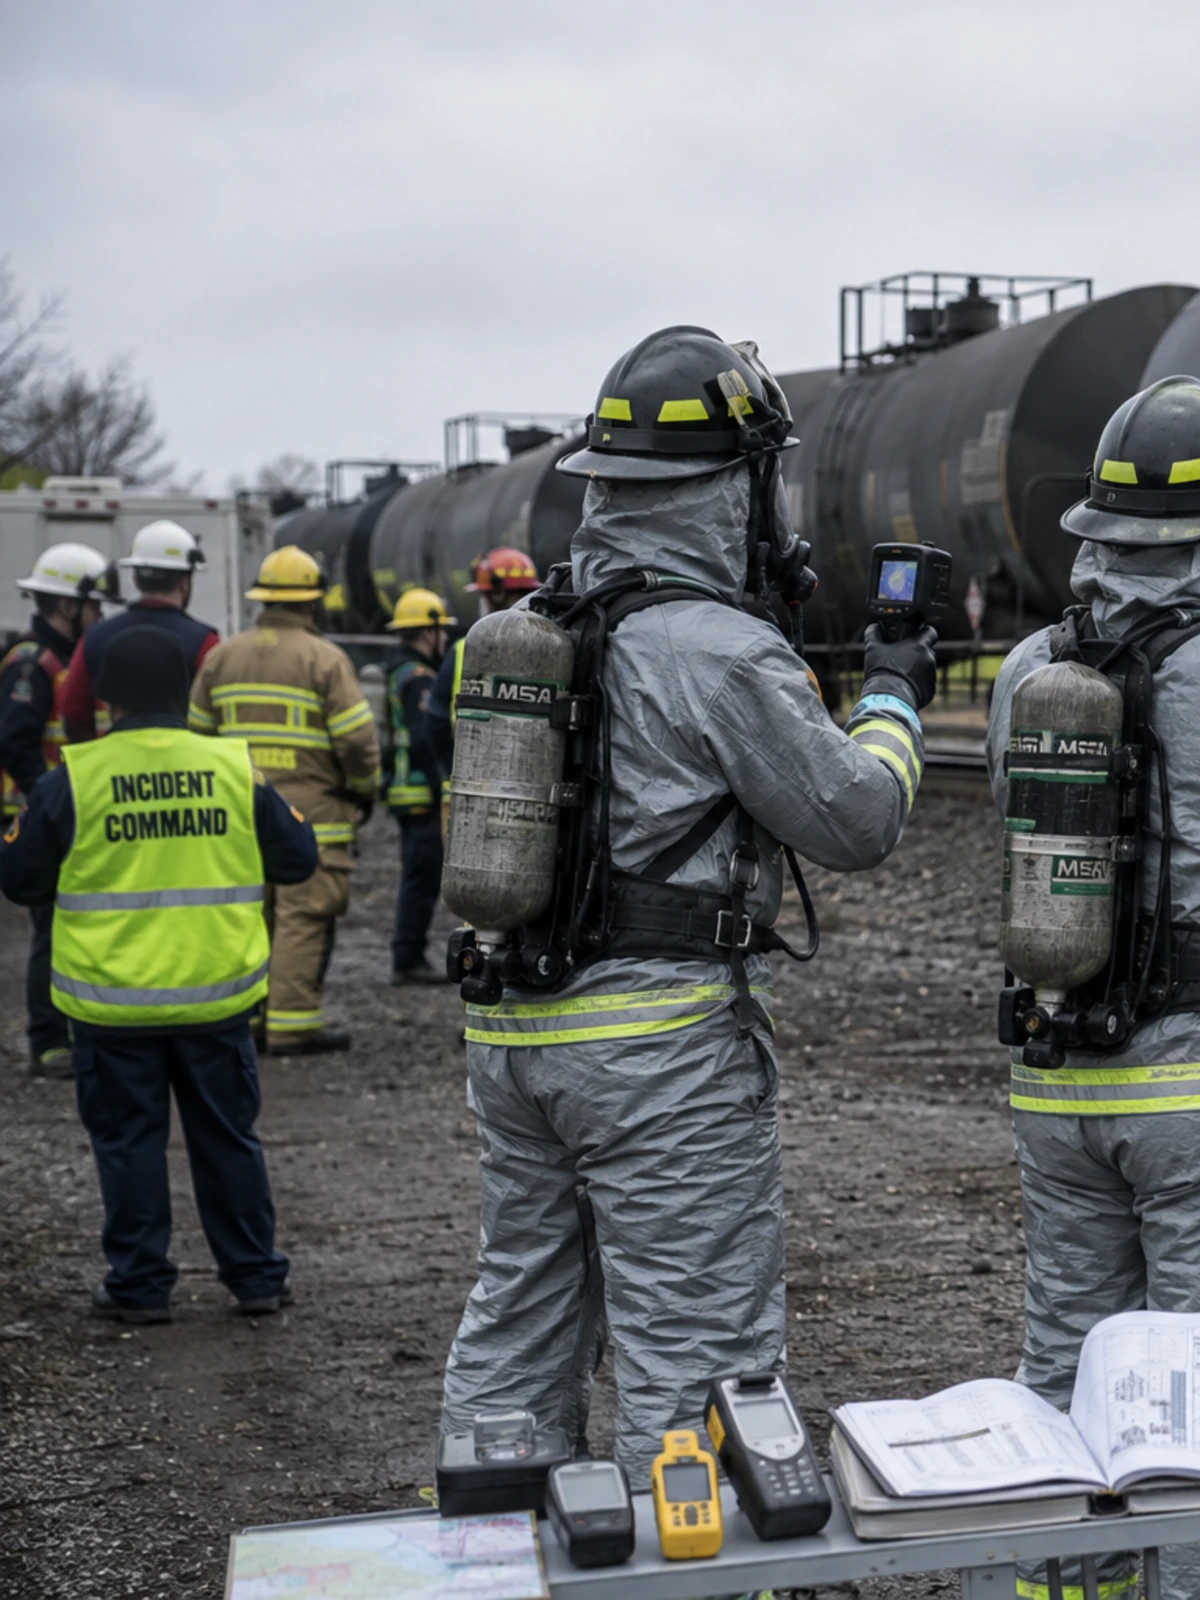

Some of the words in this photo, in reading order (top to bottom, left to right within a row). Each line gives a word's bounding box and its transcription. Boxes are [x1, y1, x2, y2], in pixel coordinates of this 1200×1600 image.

[497, 682, 553, 704] MSA
[111, 771, 215, 804] INCIDENT
[105, 808, 228, 843] COMMAND
